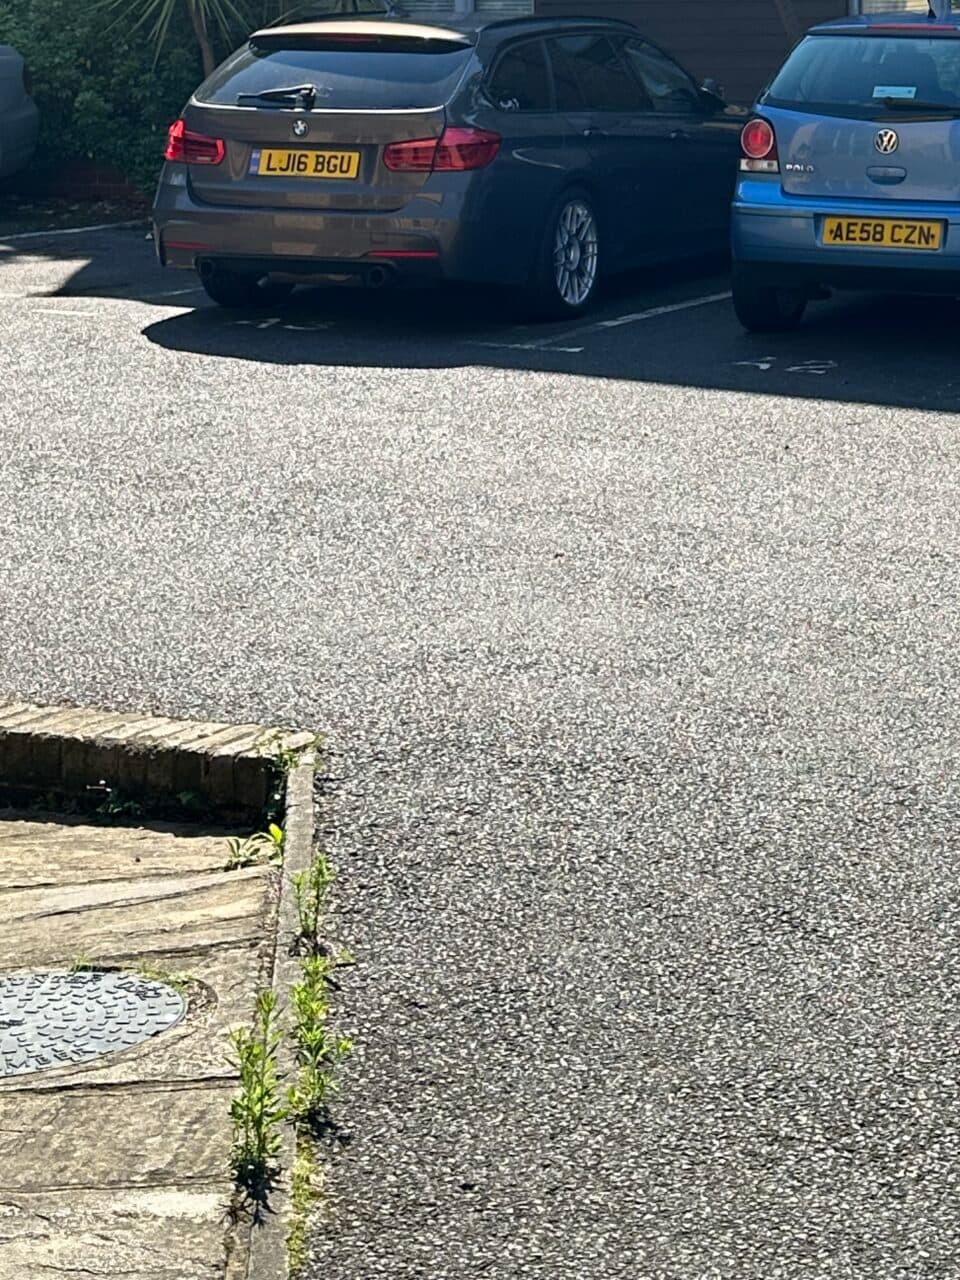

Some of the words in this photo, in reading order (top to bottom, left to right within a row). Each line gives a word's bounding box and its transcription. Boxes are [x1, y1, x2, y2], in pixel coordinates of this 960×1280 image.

[265, 152, 309, 172] LJ16
[312, 153, 352, 174] BGU
[832, 222, 885, 243] AE58
[890, 224, 932, 245] CZN
